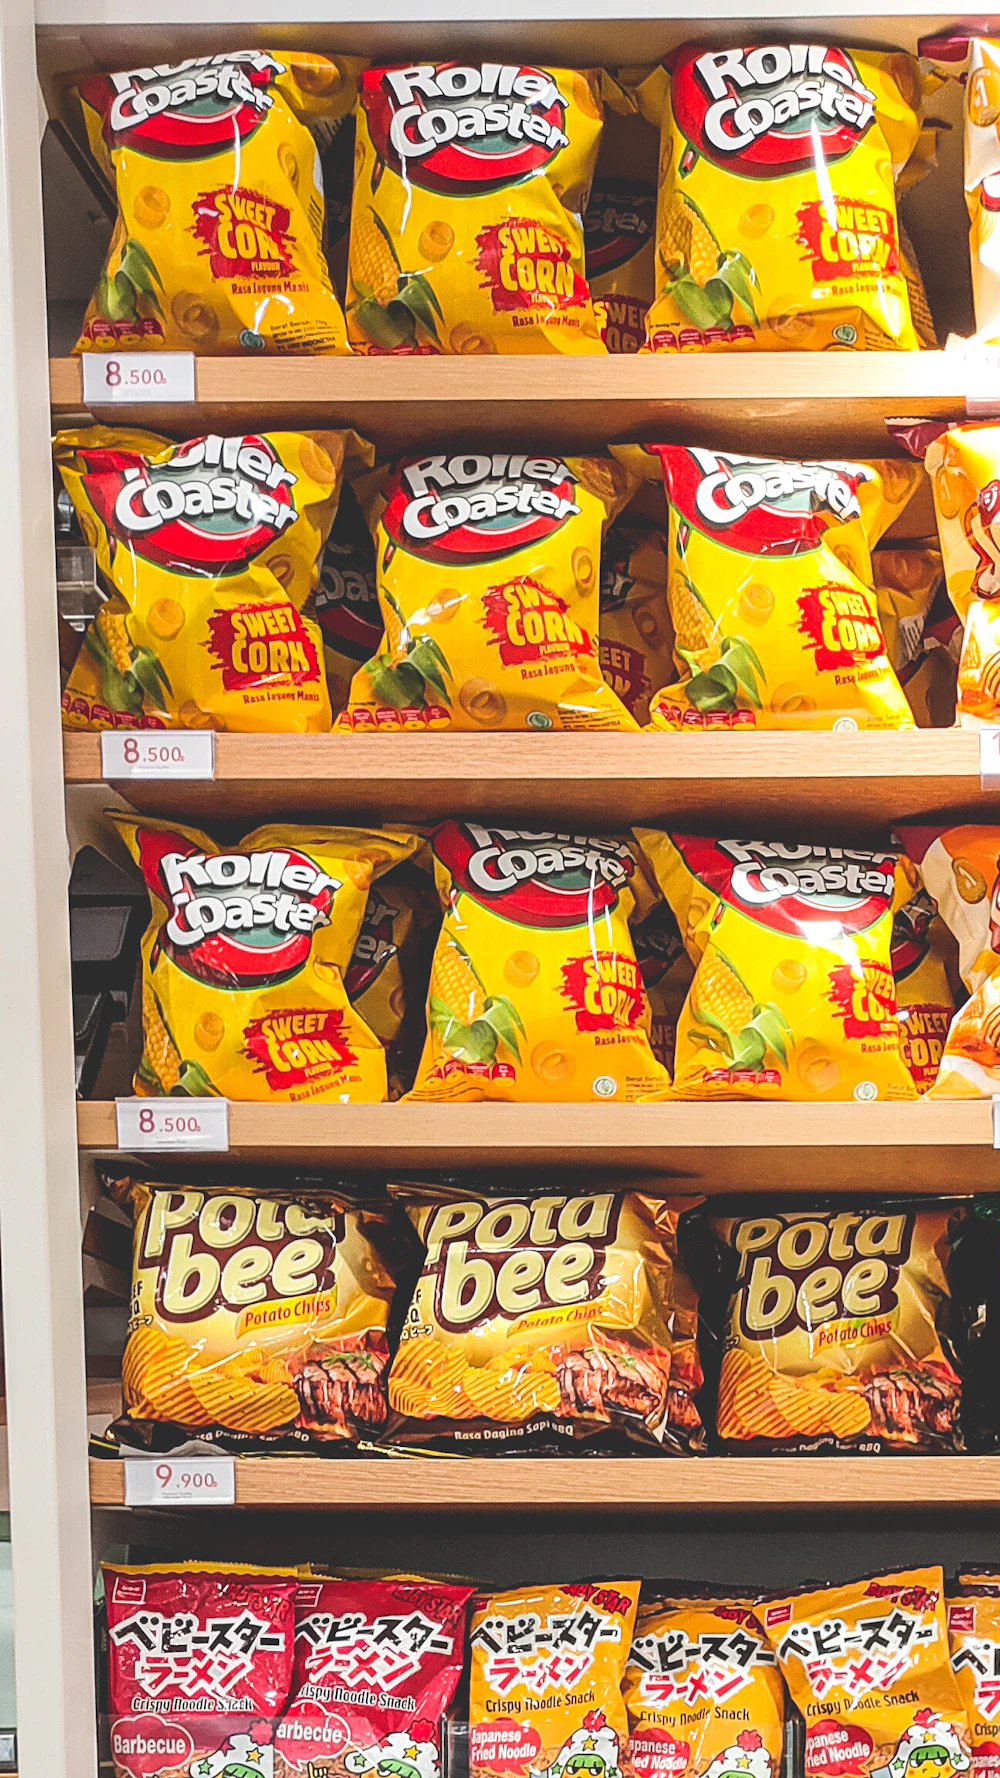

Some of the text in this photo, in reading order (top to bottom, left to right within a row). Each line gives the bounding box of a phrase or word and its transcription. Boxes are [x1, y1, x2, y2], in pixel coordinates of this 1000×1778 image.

[386, 62, 570, 108] Roller
[695, 44, 876, 100] Roller
[390, 101, 569, 157] Coaster
[704, 81, 875, 150] Coaster
[500, 257, 575, 297] CORN
[403, 455, 580, 498] Roller
[116, 477, 298, 532] Coaster
[402, 484, 582, 538] Coaster
[231, 608, 296, 640] SWEET
[506, 611, 583, 650] CORN
[232, 640, 310, 674] CORN
[123, 737, 184, 768] 8.500
[161, 851, 343, 897] Roller
[167, 893, 332, 946] Coaster
[263, 1013, 329, 1045] SWEET
[272, 1038, 344, 1073] CORN
[139, 1109, 202, 1140] 8.500
[424, 1194, 616, 1266] Pota
[737, 1213, 908, 1280] Pota
[162, 1235, 325, 1315] bee
[441, 1241, 596, 1323] bee
[746, 1256, 890, 1332] bee
[244, 1297, 332, 1329] Potato Chips
[860, 1316, 892, 1338] Chips
[156, 1463, 215, 1490] 9.900
[112, 1610, 285, 1658] ベビースター
[174, 1695, 213, 1711] Noodle
[113, 1733, 189, 1758] Barbecue
[276, 1724, 357, 1749] arbecue
[472, 1729, 522, 1747] Japanese
[472, 1745, 497, 1764] Fried
